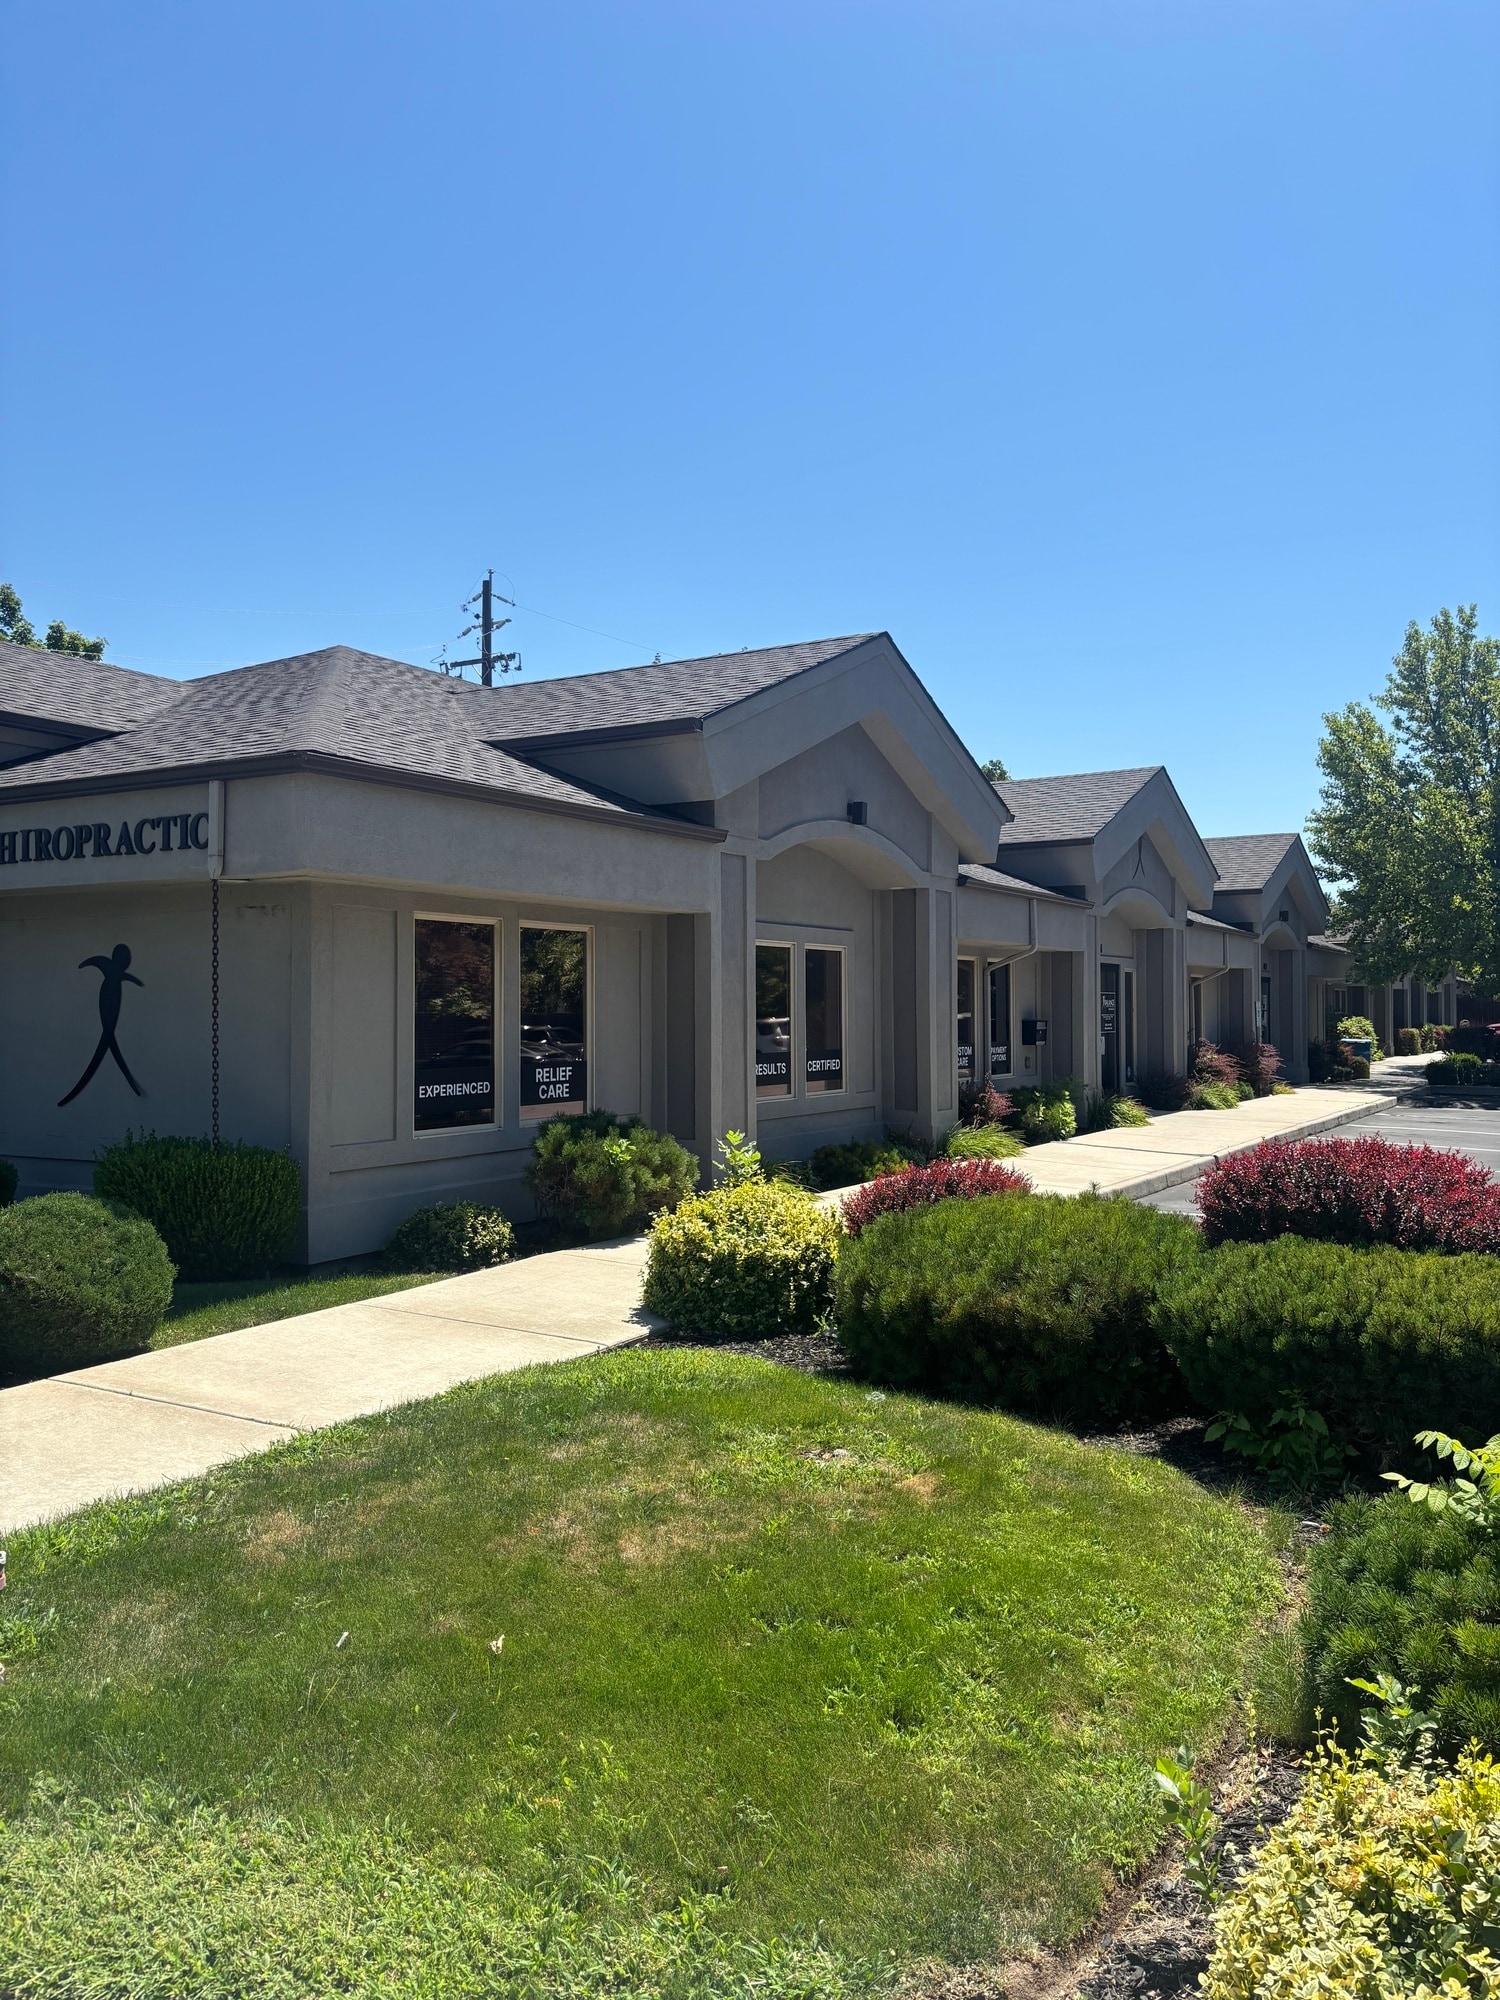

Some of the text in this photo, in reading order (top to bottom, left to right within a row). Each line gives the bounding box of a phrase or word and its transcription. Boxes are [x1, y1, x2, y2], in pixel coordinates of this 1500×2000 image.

[807, 1059, 841, 1072] CERTIFIED
[957, 1057, 969, 1066] ARE
[535, 1067, 573, 1083] RELIEF
[418, 1081, 491, 1099] EXPERIENCED
[538, 1083, 570, 1100] CARE
